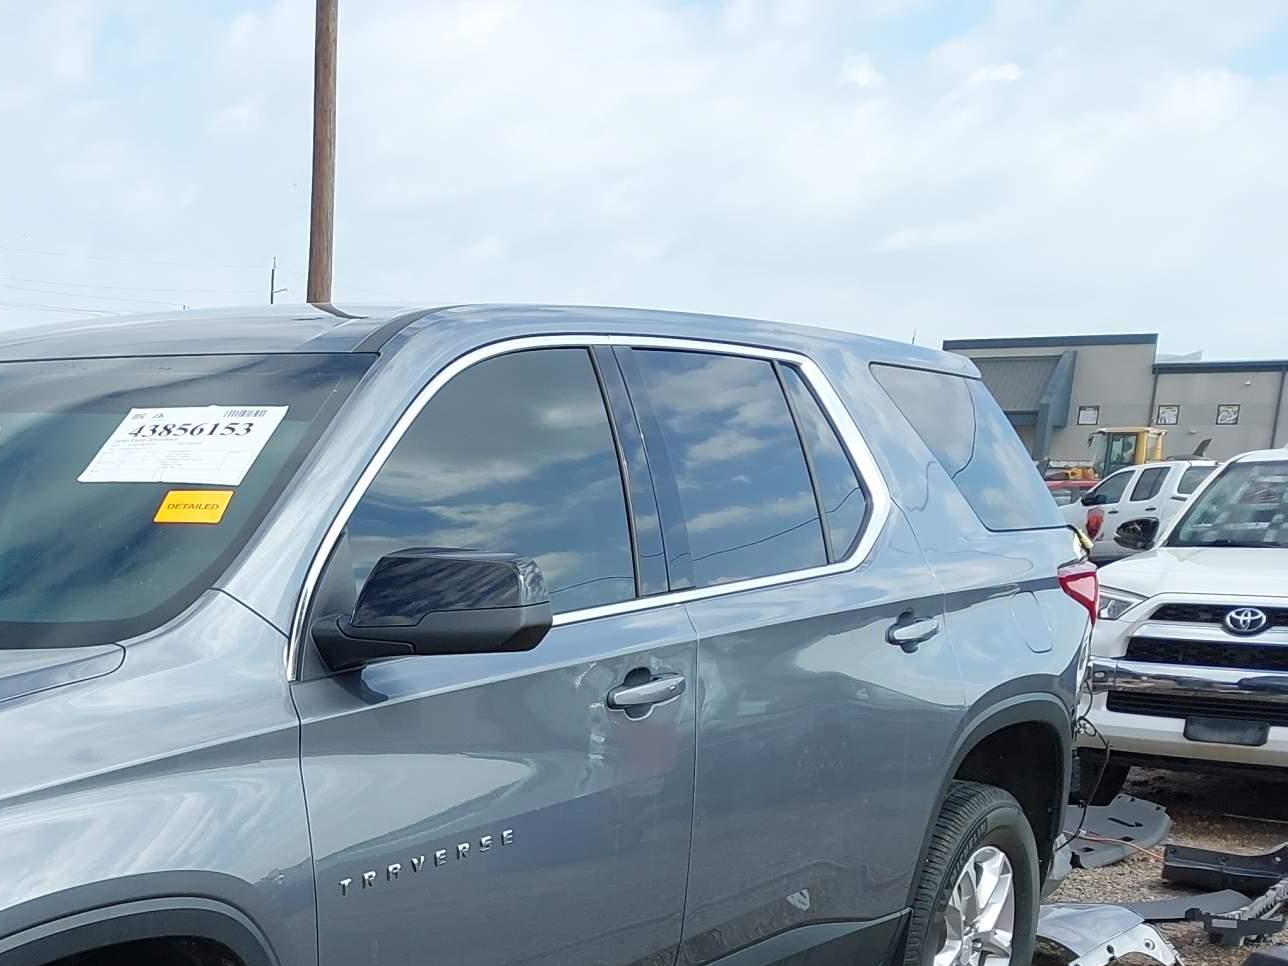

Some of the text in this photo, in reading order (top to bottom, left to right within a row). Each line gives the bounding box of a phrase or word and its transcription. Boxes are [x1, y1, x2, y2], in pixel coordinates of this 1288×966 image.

[128, 422, 255, 438] 43856153
[166, 502, 220, 511] DETAILED
[338, 829, 514, 897] TRAVERSE
